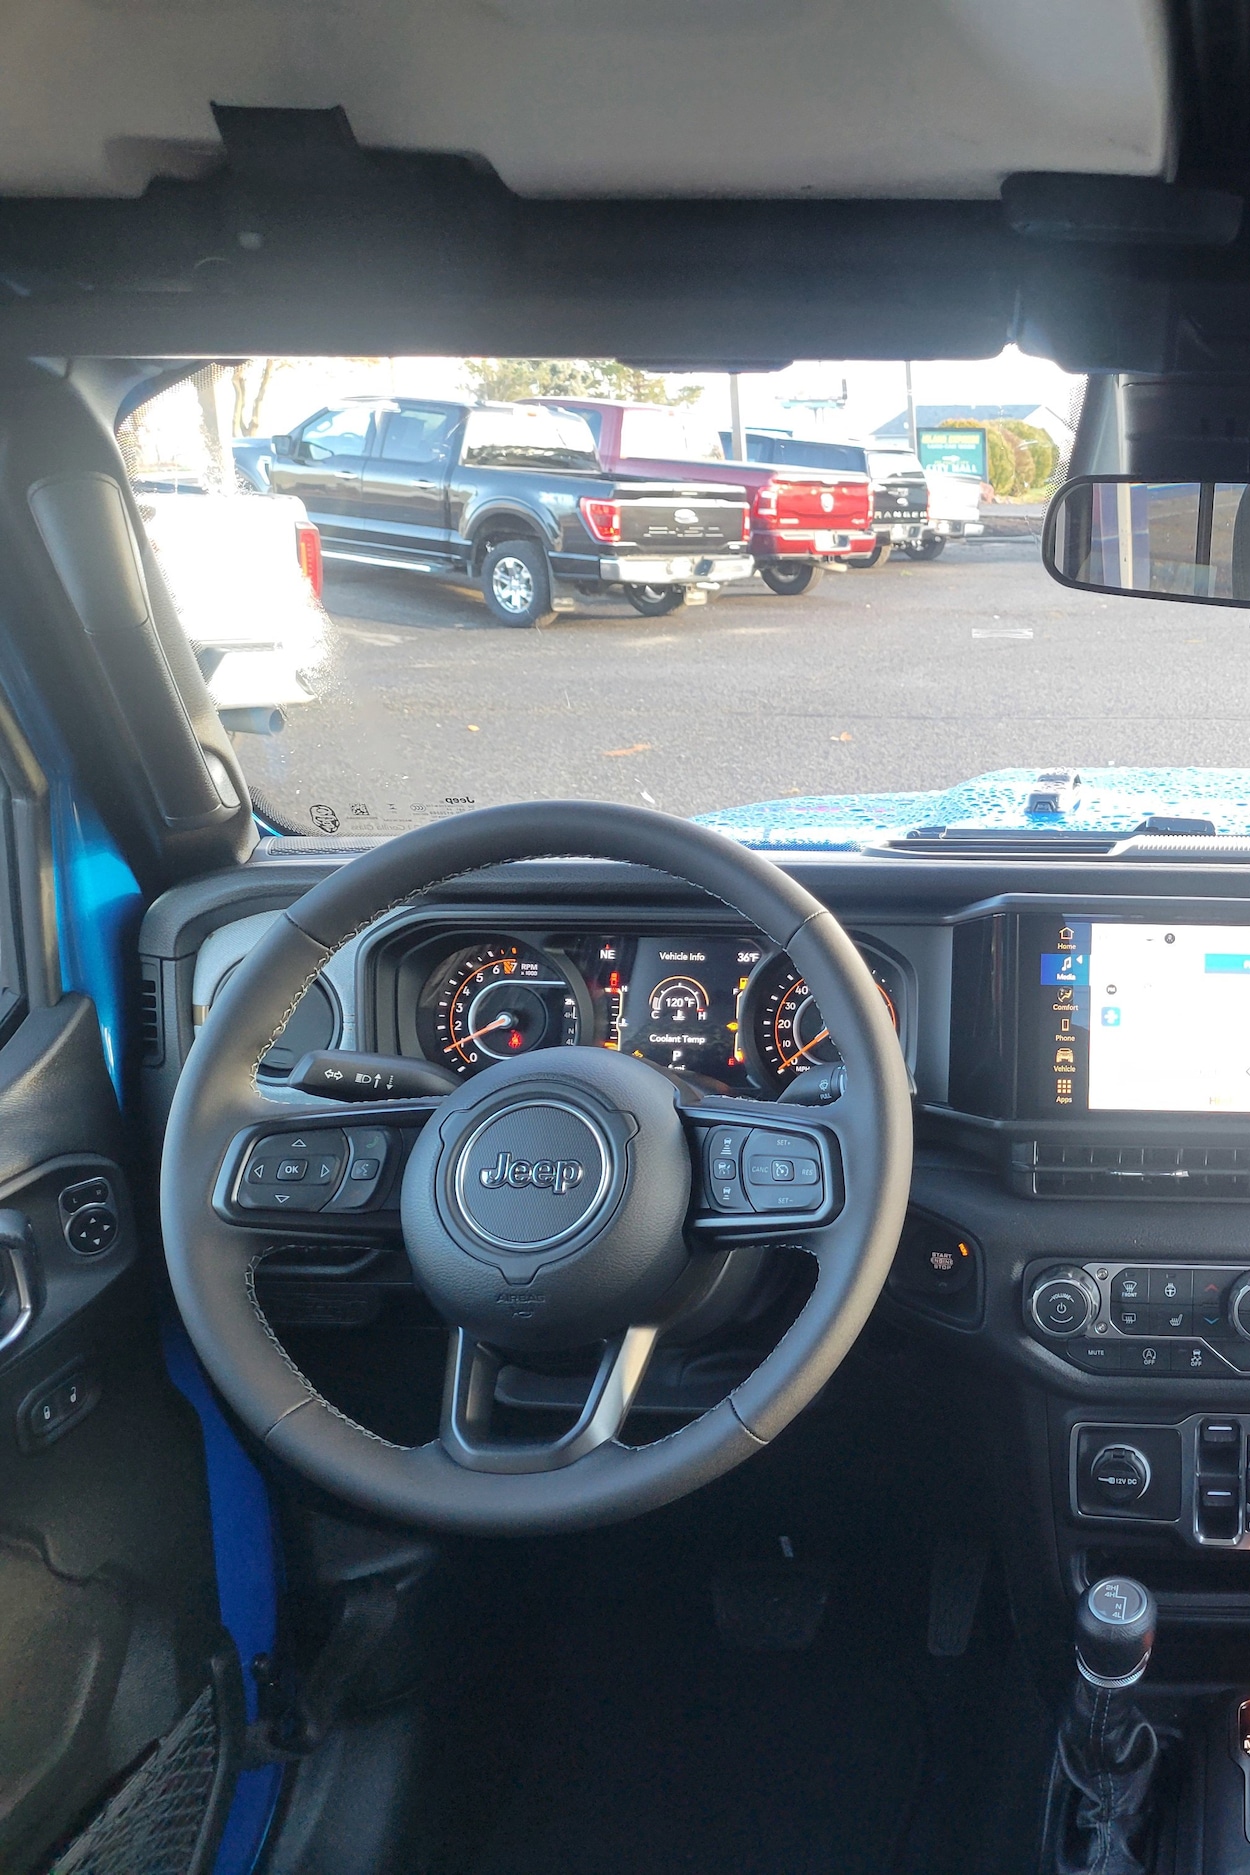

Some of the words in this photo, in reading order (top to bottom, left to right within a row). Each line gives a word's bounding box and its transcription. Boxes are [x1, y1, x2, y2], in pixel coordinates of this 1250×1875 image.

[600, 950, 615, 959] NE
[660, 952, 688, 960] Vehicle
[690, 952, 705, 961] Info
[493, 965, 500, 974] 6
[511, 963, 517, 973] 7
[476, 973, 484, 982] 5
[463, 987, 470, 996] 4
[795, 986, 808, 994] 40
[456, 1003, 463, 1013] 3
[651, 1011, 660, 1019] C
[699, 1012, 706, 1020] H
[455, 1021, 462, 1030] 2
[778, 1020, 791, 1029] 20
[650, 1034, 682, 1043] Coolant
[683, 1035, 705, 1045] Temp
[470, 1053, 477, 1062] 0
[672, 1051, 681, 1061] P
[480, 1152, 583, 1194] Jeep
